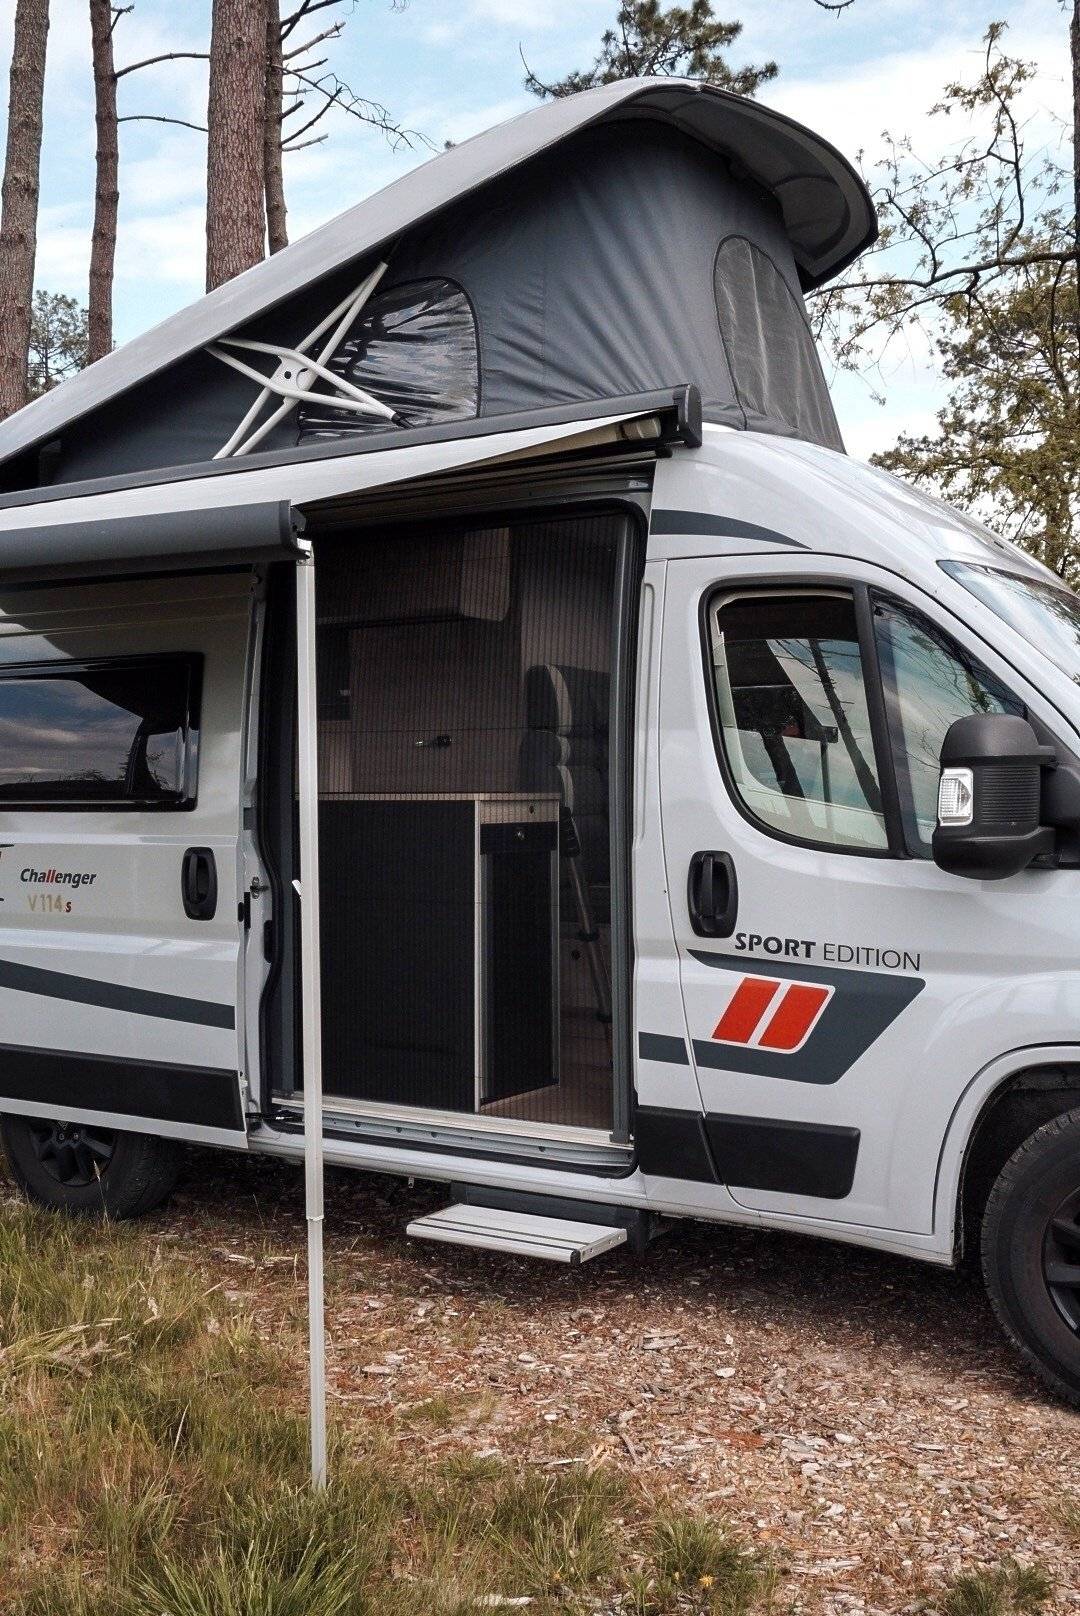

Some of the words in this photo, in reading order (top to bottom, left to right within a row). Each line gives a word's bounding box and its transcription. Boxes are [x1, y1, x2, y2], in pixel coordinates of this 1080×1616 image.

[20, 868, 97, 888] Challenger
[734, 932, 816, 958] SPORT
[823, 943, 921, 971] EDITION
